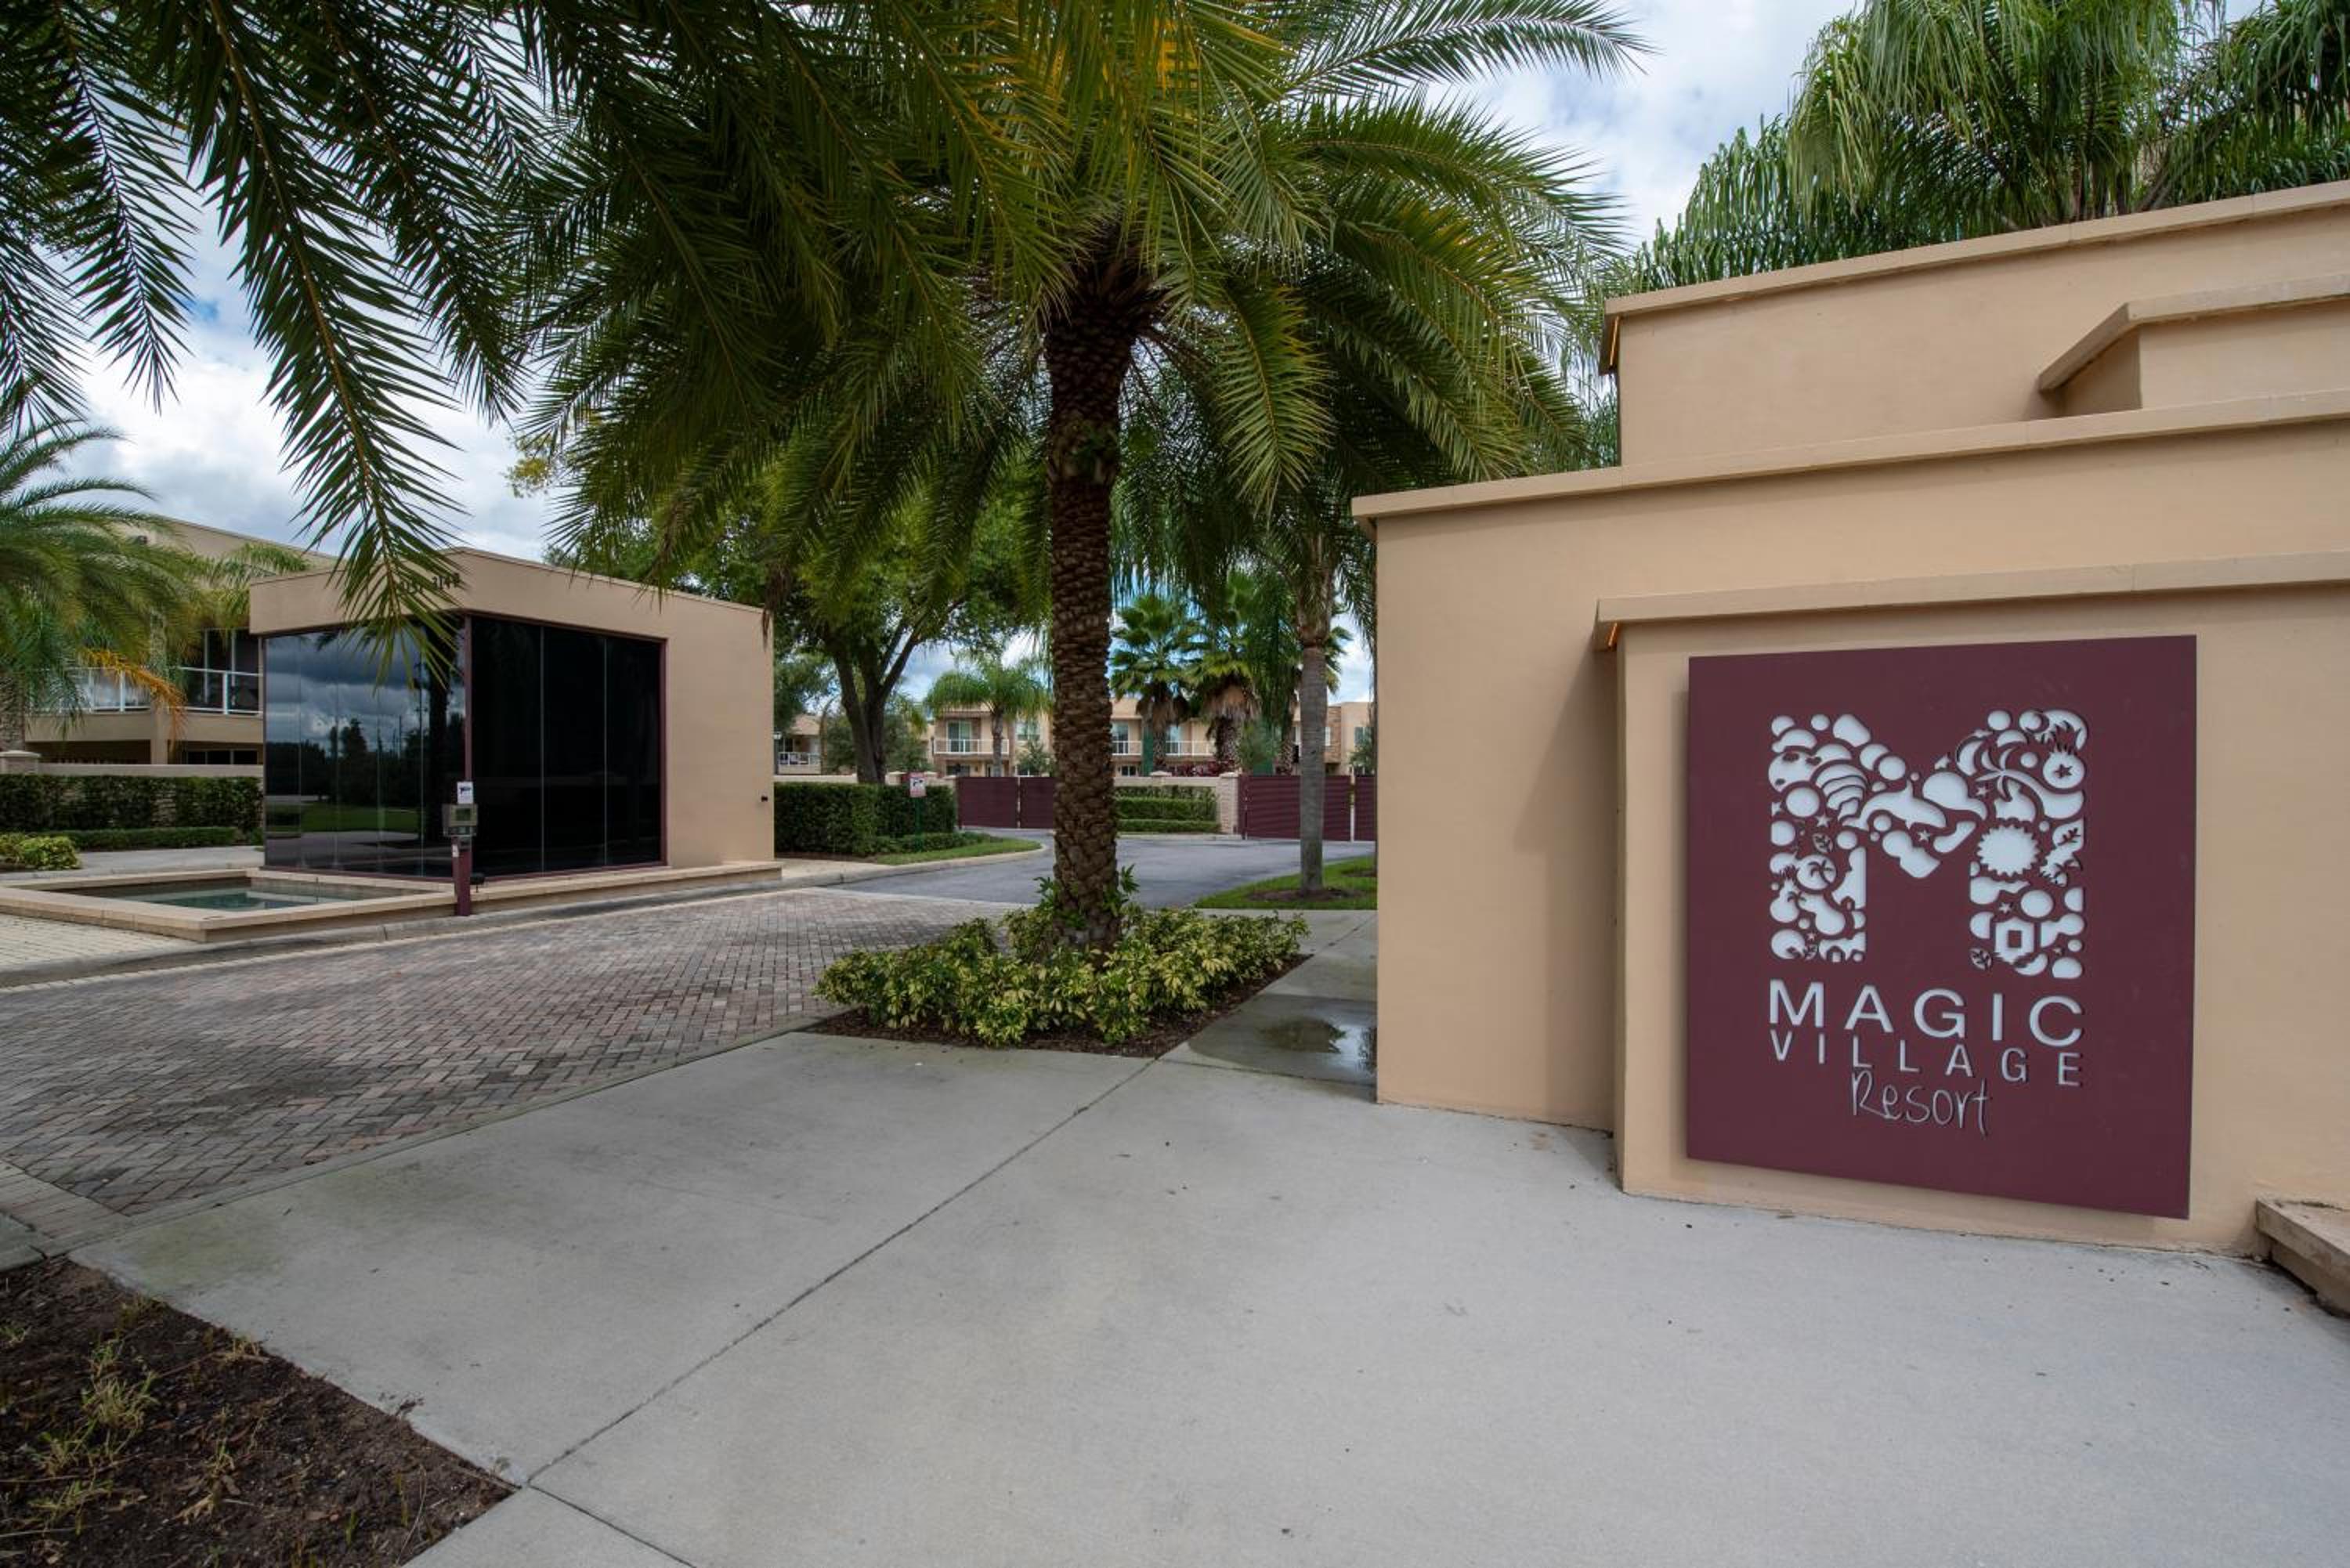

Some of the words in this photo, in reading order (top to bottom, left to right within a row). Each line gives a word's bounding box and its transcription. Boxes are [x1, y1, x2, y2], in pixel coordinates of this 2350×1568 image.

[1769, 978, 2083, 1048] MAGIC
[1770, 1029, 2082, 1087] VILLAGE
[1850, 1068, 1989, 1134] Resort
